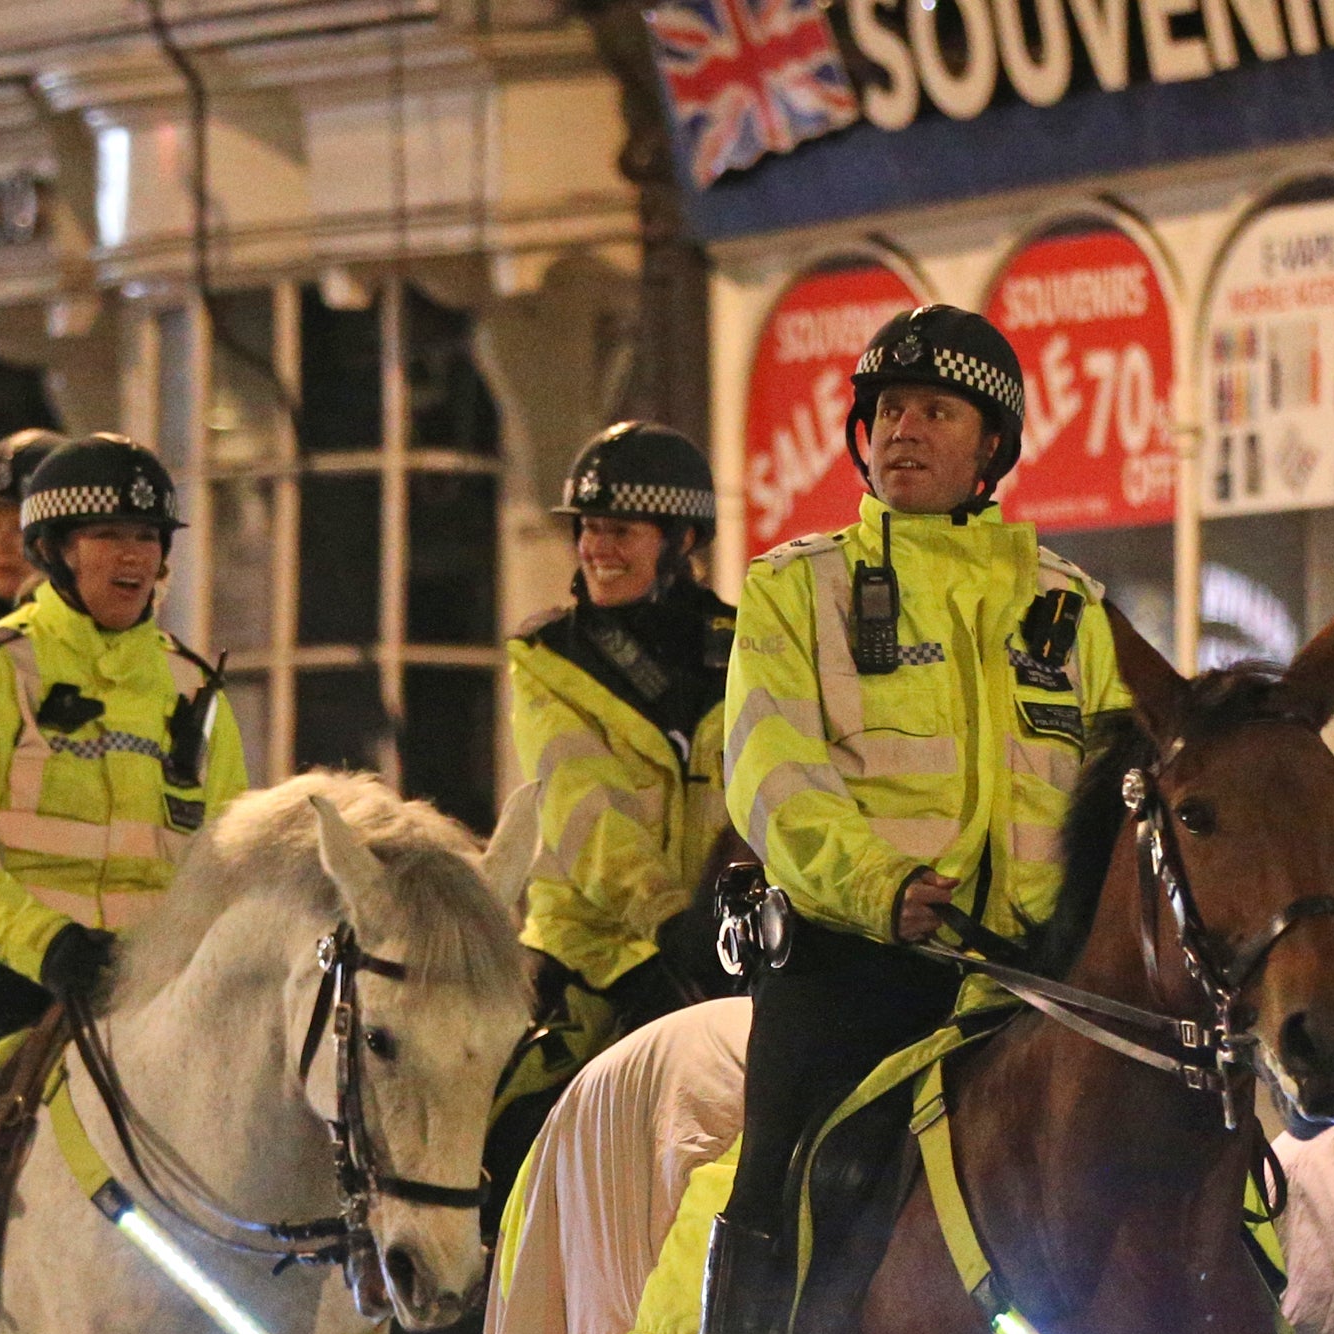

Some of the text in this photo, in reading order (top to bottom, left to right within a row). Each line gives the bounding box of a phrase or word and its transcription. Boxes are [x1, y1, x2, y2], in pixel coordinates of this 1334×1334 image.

[1001, 265, 1148, 330] SOUVENIRS
[748, 368, 850, 541] SALE
[737, 634, 786, 655] OLICE
